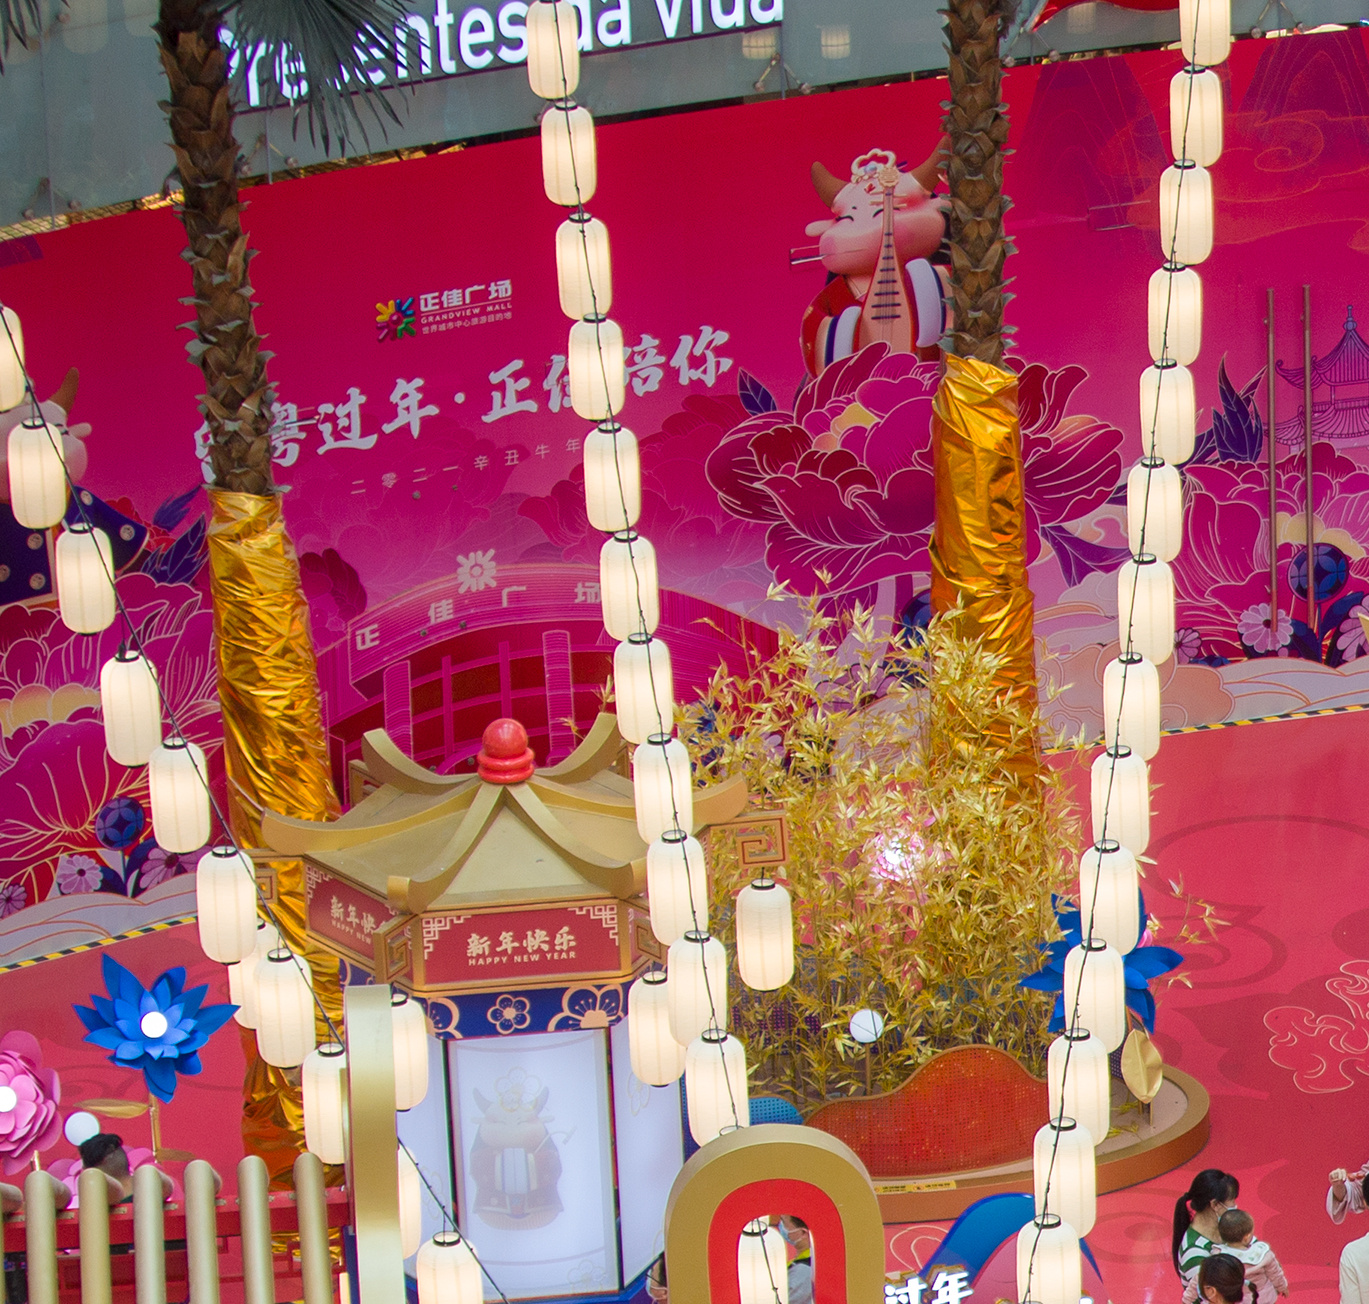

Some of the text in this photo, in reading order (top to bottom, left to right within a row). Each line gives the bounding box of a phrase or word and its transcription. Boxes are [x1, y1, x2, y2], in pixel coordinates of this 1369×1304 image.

[419, 278, 513, 313] 正佳广场
[420, 302, 513, 325] GRANDVIEW MALL
[330, 895, 387, 936] 新年快
[467, 926, 577, 957] 新年快乐
[468, 951, 577, 966] HAPPY NEW YEAR
